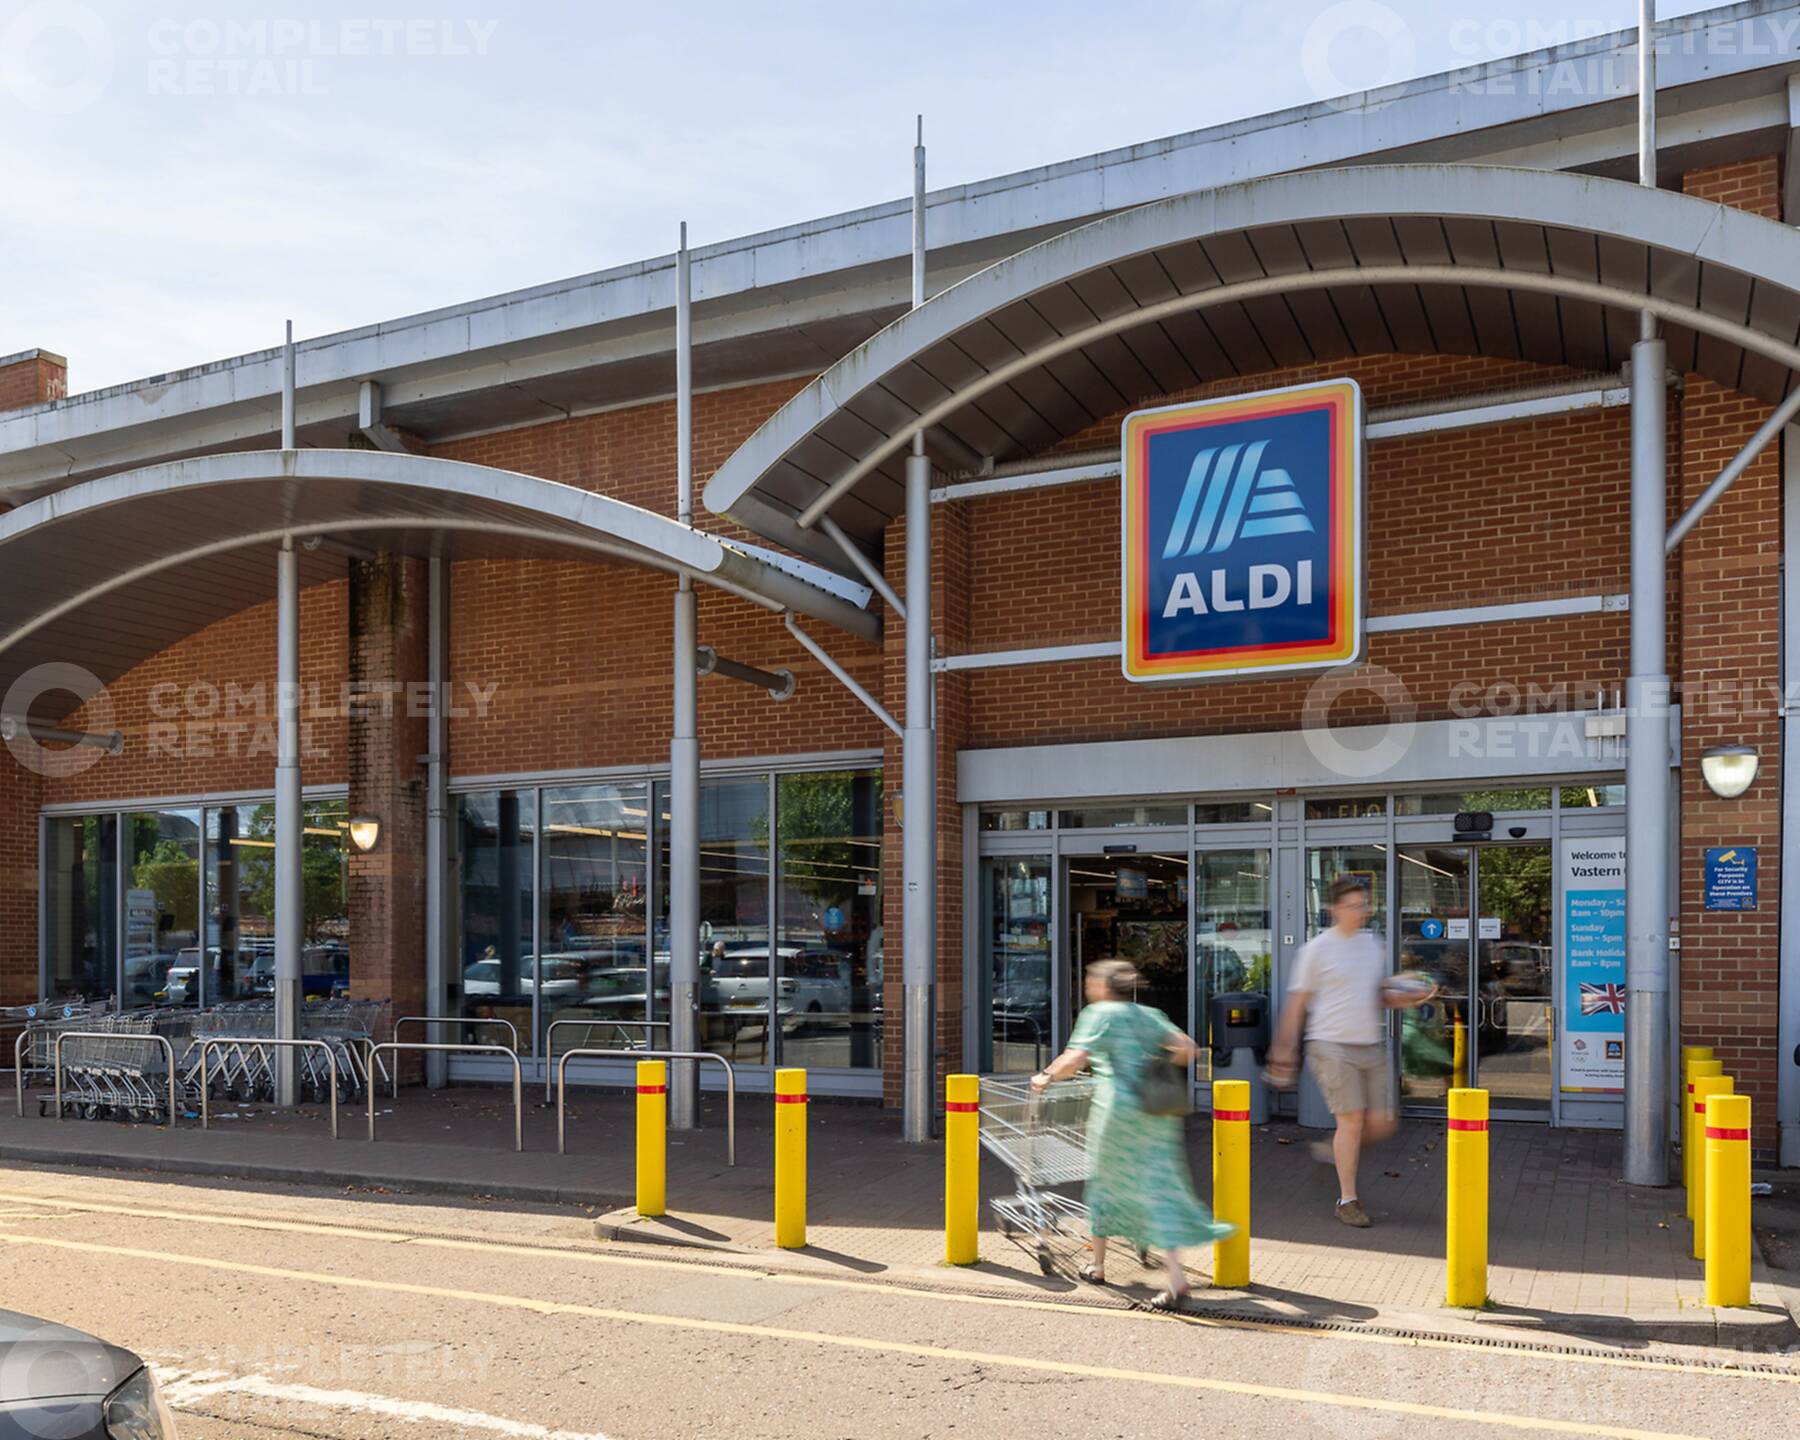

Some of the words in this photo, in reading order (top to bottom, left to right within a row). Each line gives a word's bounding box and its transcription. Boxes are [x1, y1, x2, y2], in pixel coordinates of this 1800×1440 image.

[1162, 560, 1312, 618] ALDI
[1571, 851, 1617, 860] Welcome
[1571, 866, 1621, 877] Vastern
[1571, 899, 1607, 909] Monday
[1600, 909, 1625, 919] 10pm
[1571, 924, 1605, 934] Sunday
[1571, 934, 1593, 942] 11am
[1571, 949, 1594, 957] Bank
[1596, 949, 1626, 957] Holida
